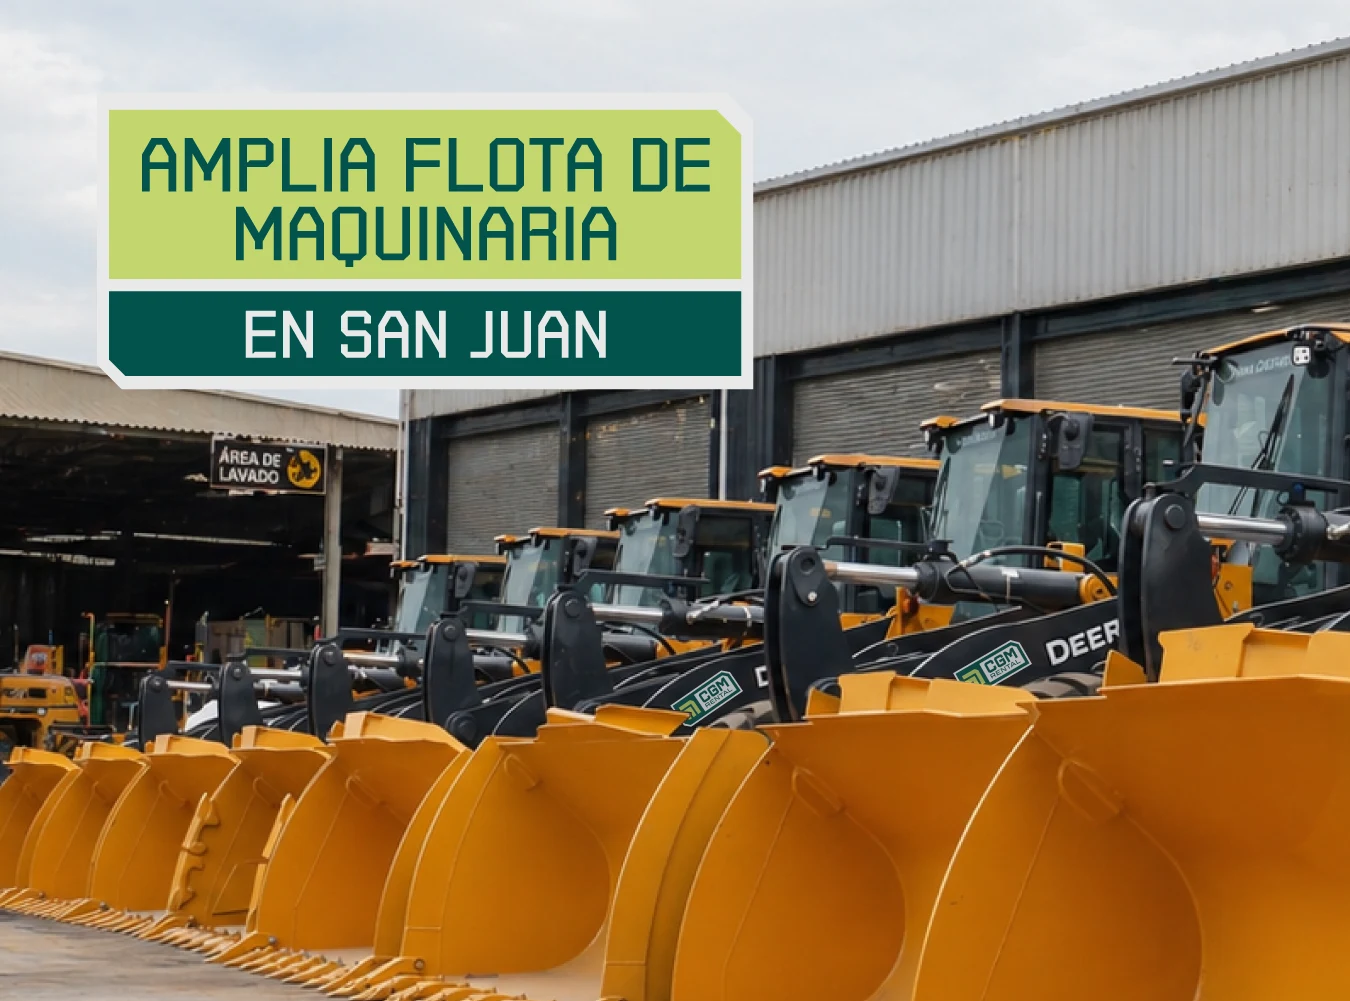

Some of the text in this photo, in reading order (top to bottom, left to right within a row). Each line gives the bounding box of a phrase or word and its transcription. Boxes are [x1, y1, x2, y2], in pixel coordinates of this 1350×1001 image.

[219, 445, 282, 468] ÁREA DE
[219, 466, 279, 484] LAVADO
[1045, 618, 1120, 667] DEER
[984, 647, 1018, 673] CGM
[989, 659, 1021, 680] RENTAL
[698, 676, 730, 703] CGM
[704, 688, 733, 708] RENTAL
